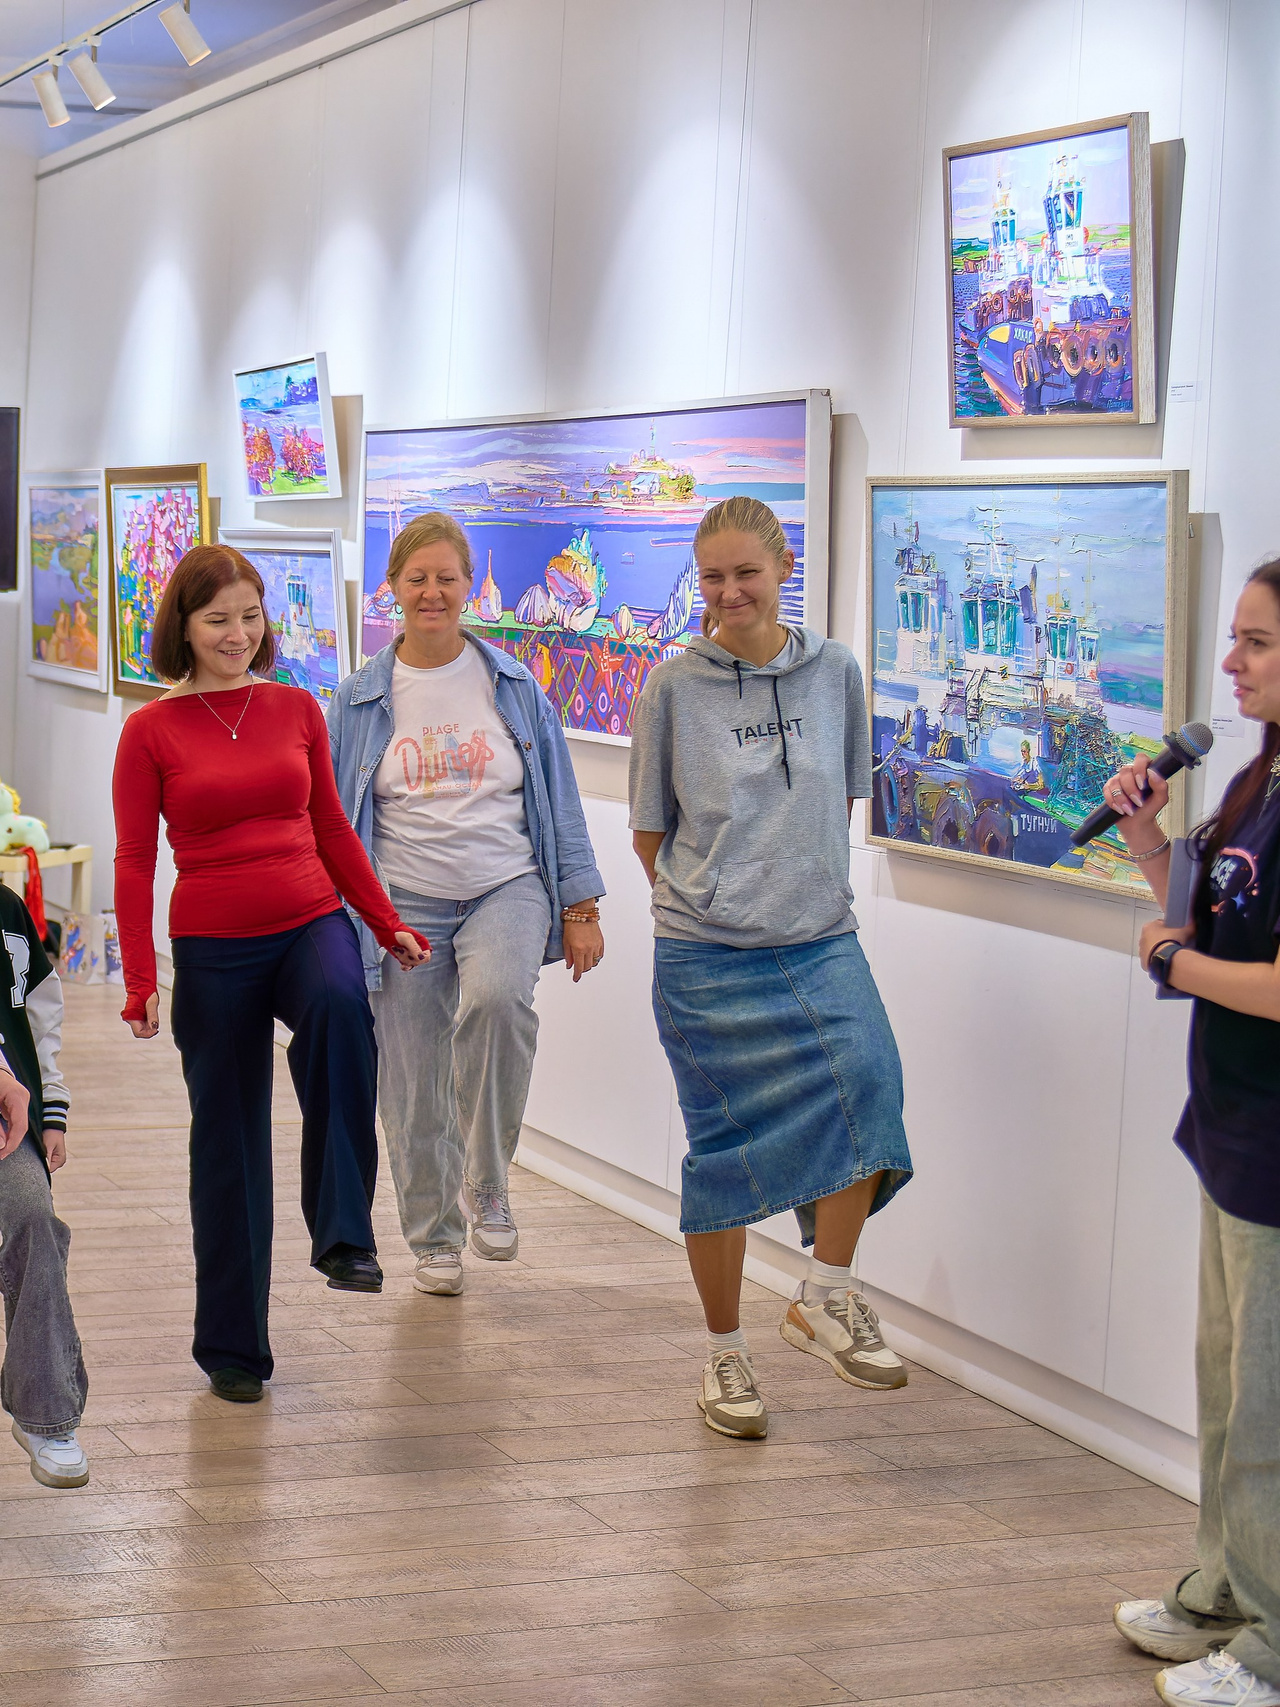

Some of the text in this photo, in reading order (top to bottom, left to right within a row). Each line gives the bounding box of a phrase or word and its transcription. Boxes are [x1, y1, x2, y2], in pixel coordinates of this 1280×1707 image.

[422, 723, 460, 737] PLAGE
[730, 718, 803, 748] TALENT
[394, 735, 495, 792] Dunes
